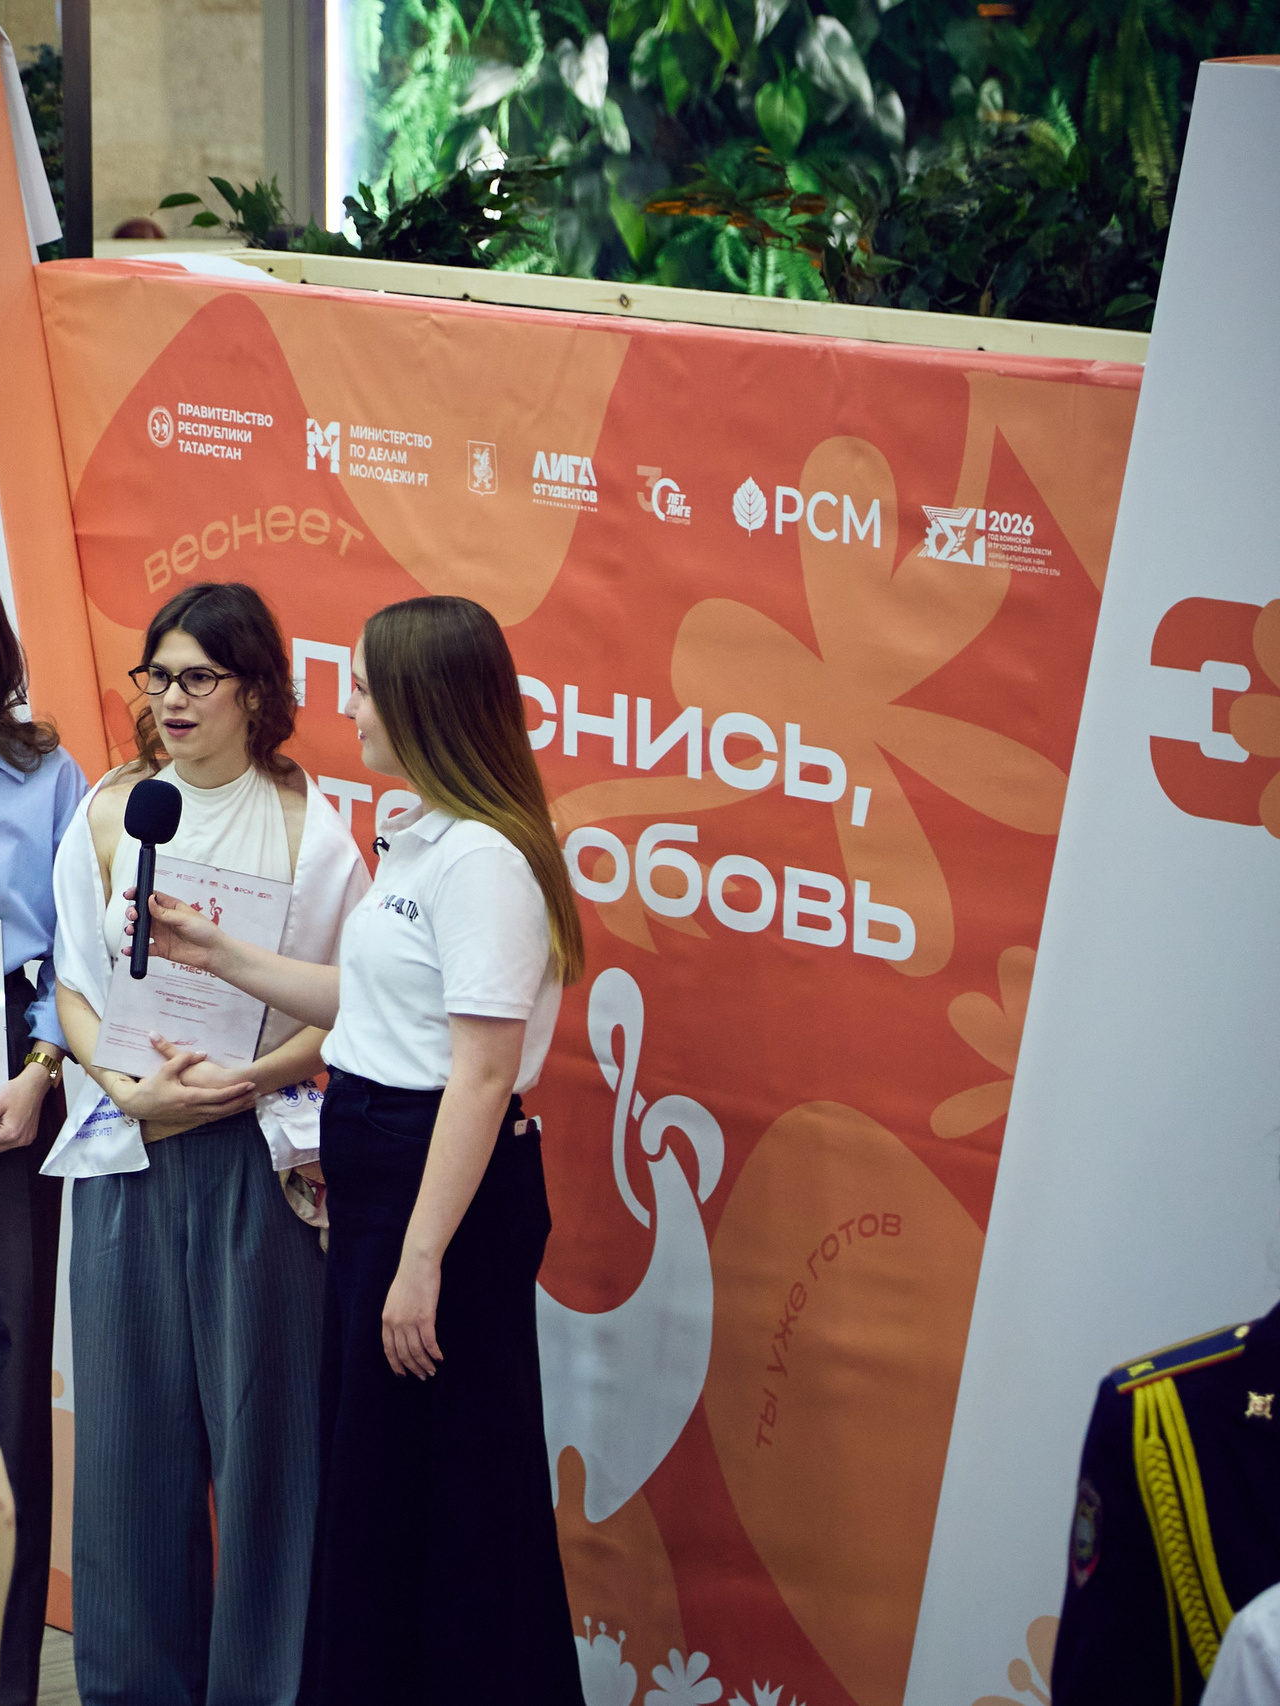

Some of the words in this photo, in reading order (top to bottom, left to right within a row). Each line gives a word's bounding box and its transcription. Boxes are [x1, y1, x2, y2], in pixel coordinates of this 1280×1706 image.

[177, 402, 273, 428] ПРАВИТЕЛЬСТВО
[177, 420, 252, 444] РЕСПУБЛИКИ
[349, 424, 433, 449] МИНИСТЕРСТВО
[178, 439, 242, 460] ТАТАРСТАН
[349, 444, 365, 459] ПО
[367, 446, 407, 464] ДЕЛАМ
[349, 464, 415, 485] МОЛОДЕЖИ
[418, 472, 429, 487] РТ
[532, 450, 597, 487] ЛИГА
[533, 482, 598, 503] СТУДЕНТОВ
[666, 492, 687, 506] ЛЕТ
[666, 503, 692, 518] ЛИГЕ
[775, 485, 881, 548] РСМ
[988, 510, 1035, 536] 2026
